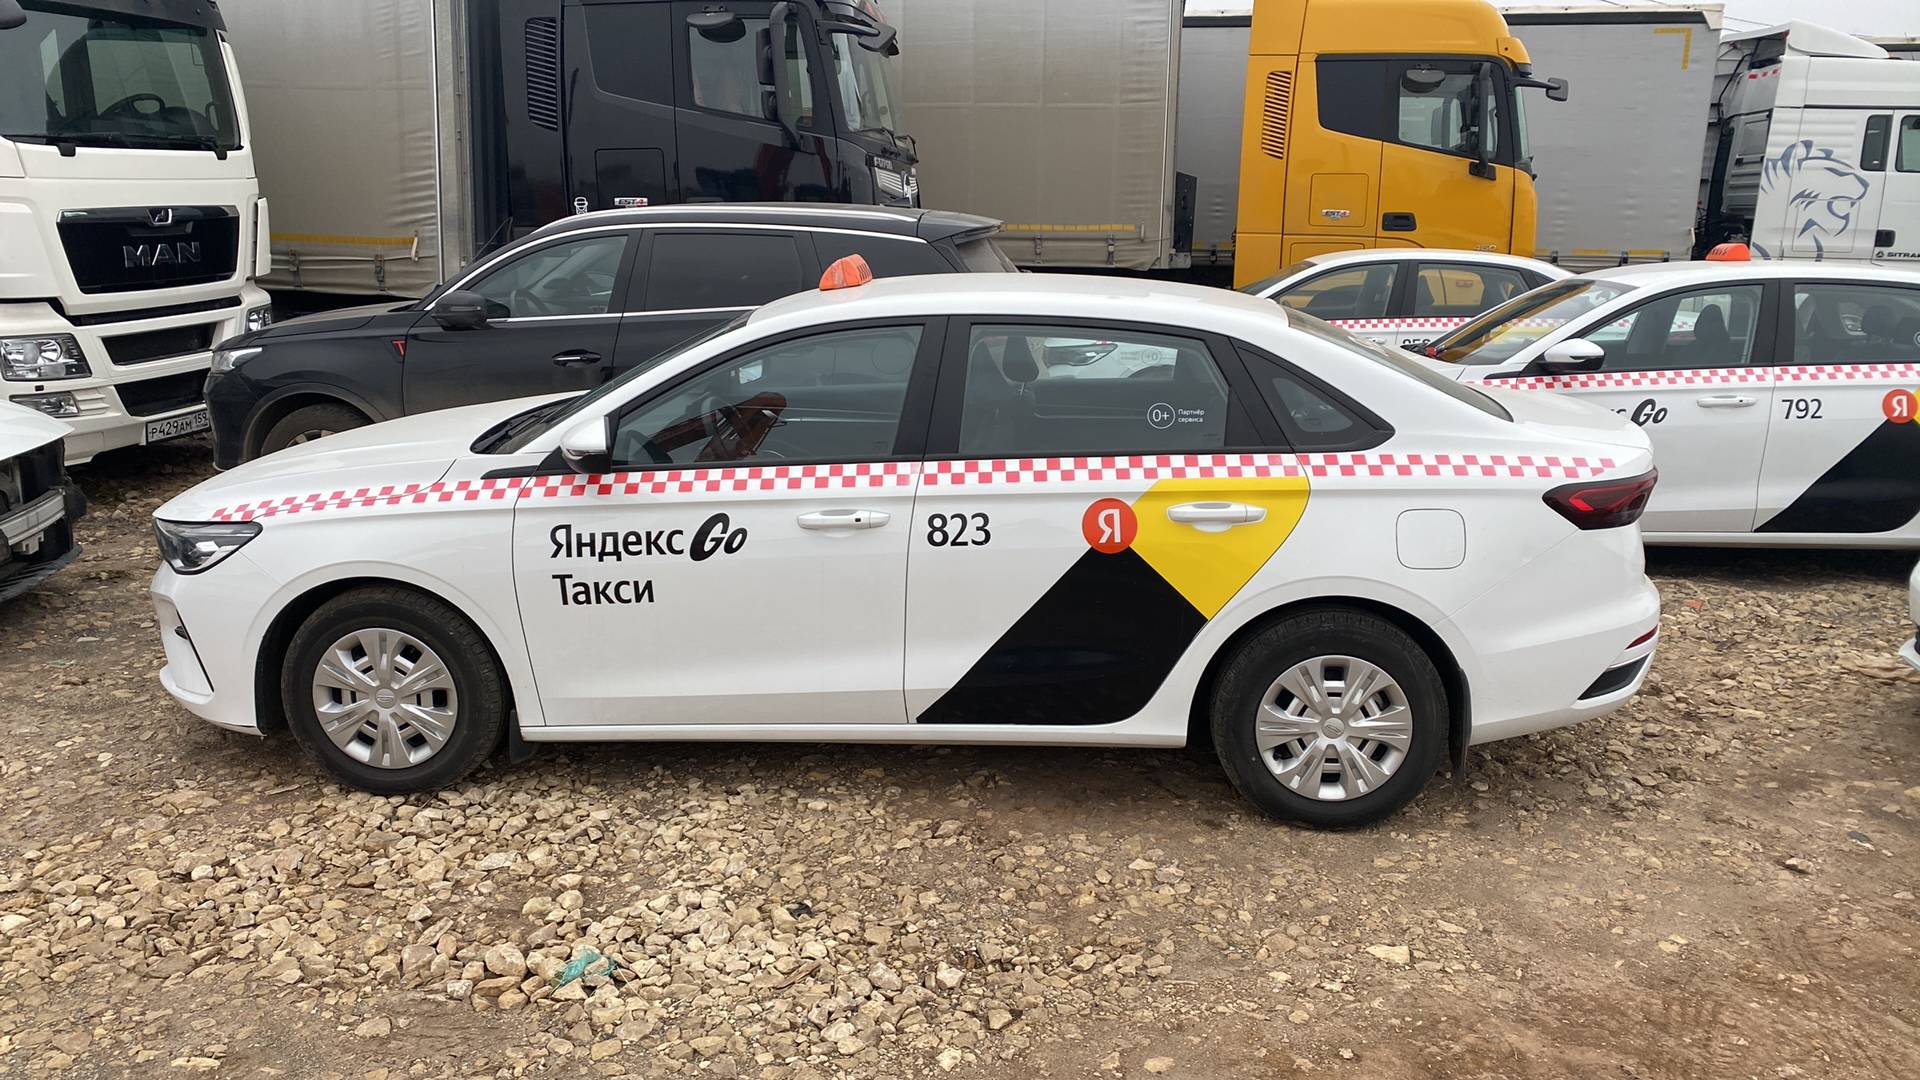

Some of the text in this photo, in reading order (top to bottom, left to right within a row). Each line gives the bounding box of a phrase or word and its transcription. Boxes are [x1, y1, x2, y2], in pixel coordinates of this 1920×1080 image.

[122, 242, 201, 268] MAN
[1152, 409, 1170, 422] 0+
[1631, 398, 1668, 427] Go
[1782, 398, 1823, 419] 792
[1892, 396, 1908, 417] Я
[550, 512, 748, 562] Яндекс Go
[927, 512, 991, 547] 823
[1097, 508, 1121, 544] Я
[552, 574, 655, 606] Такси
